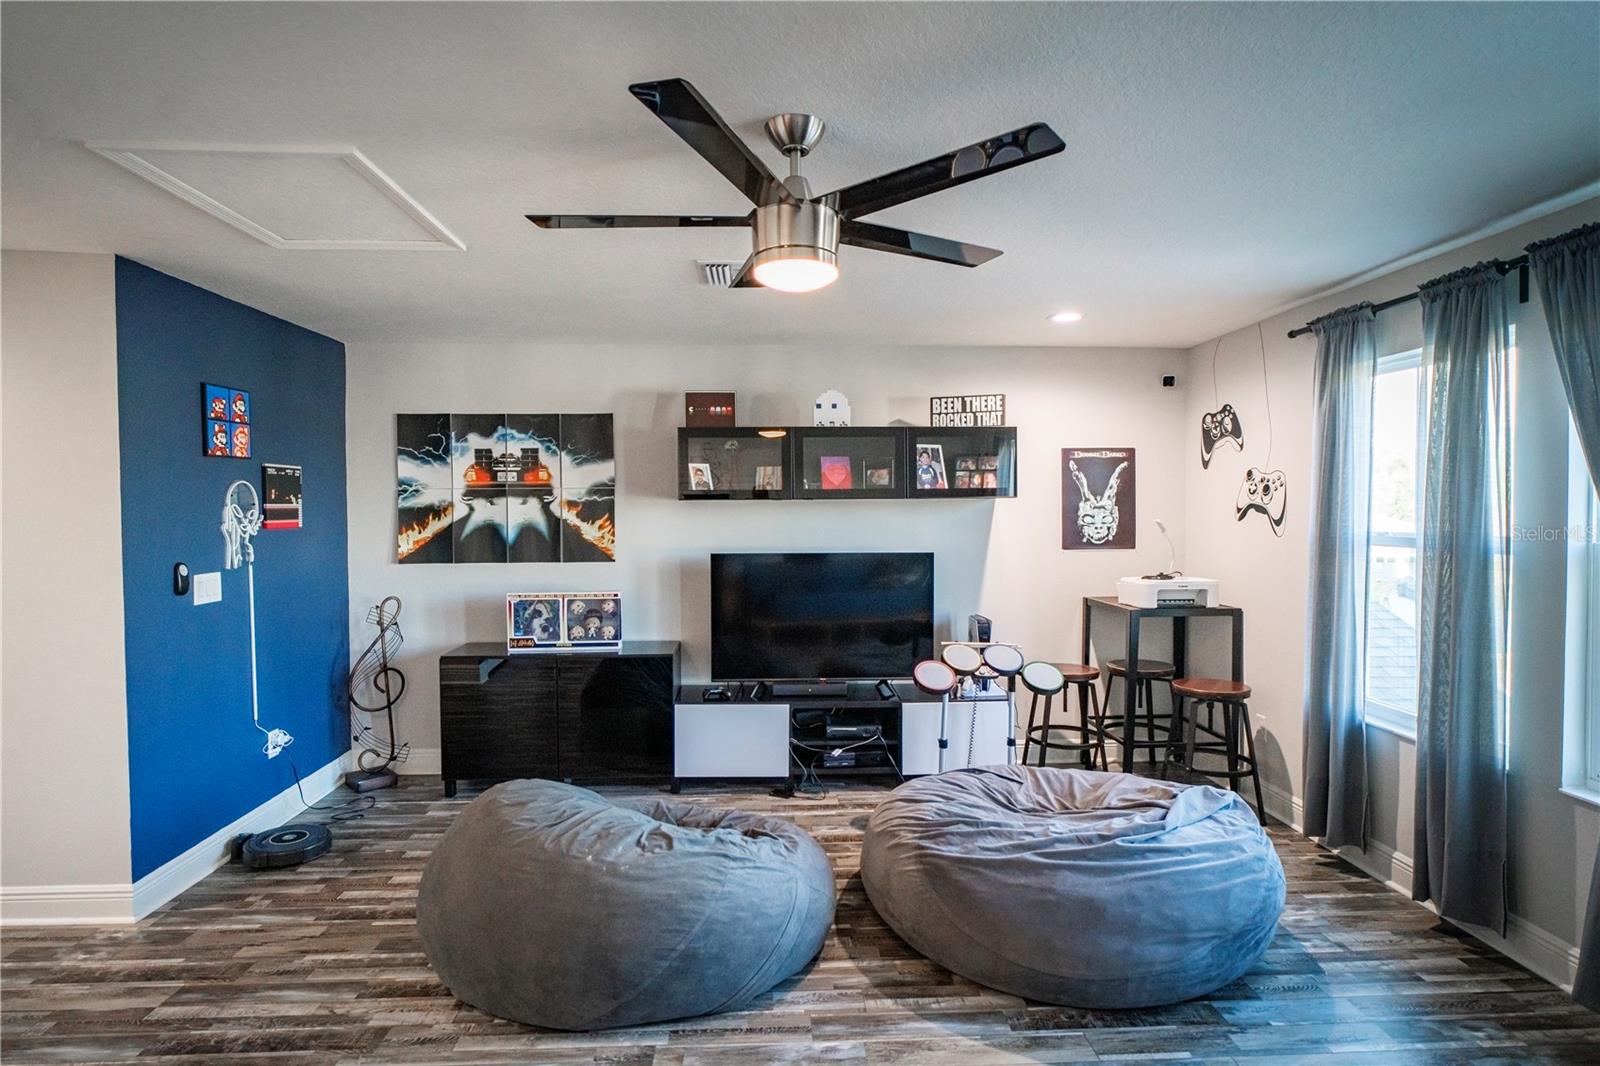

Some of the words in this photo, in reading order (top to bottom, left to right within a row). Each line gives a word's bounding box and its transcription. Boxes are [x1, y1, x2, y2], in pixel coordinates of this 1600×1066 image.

[932, 397, 962, 413] BEEN
[964, 395, 1003, 412] THERE
[932, 413, 975, 427] ROCKED
[976, 411, 1003, 426] THAT
